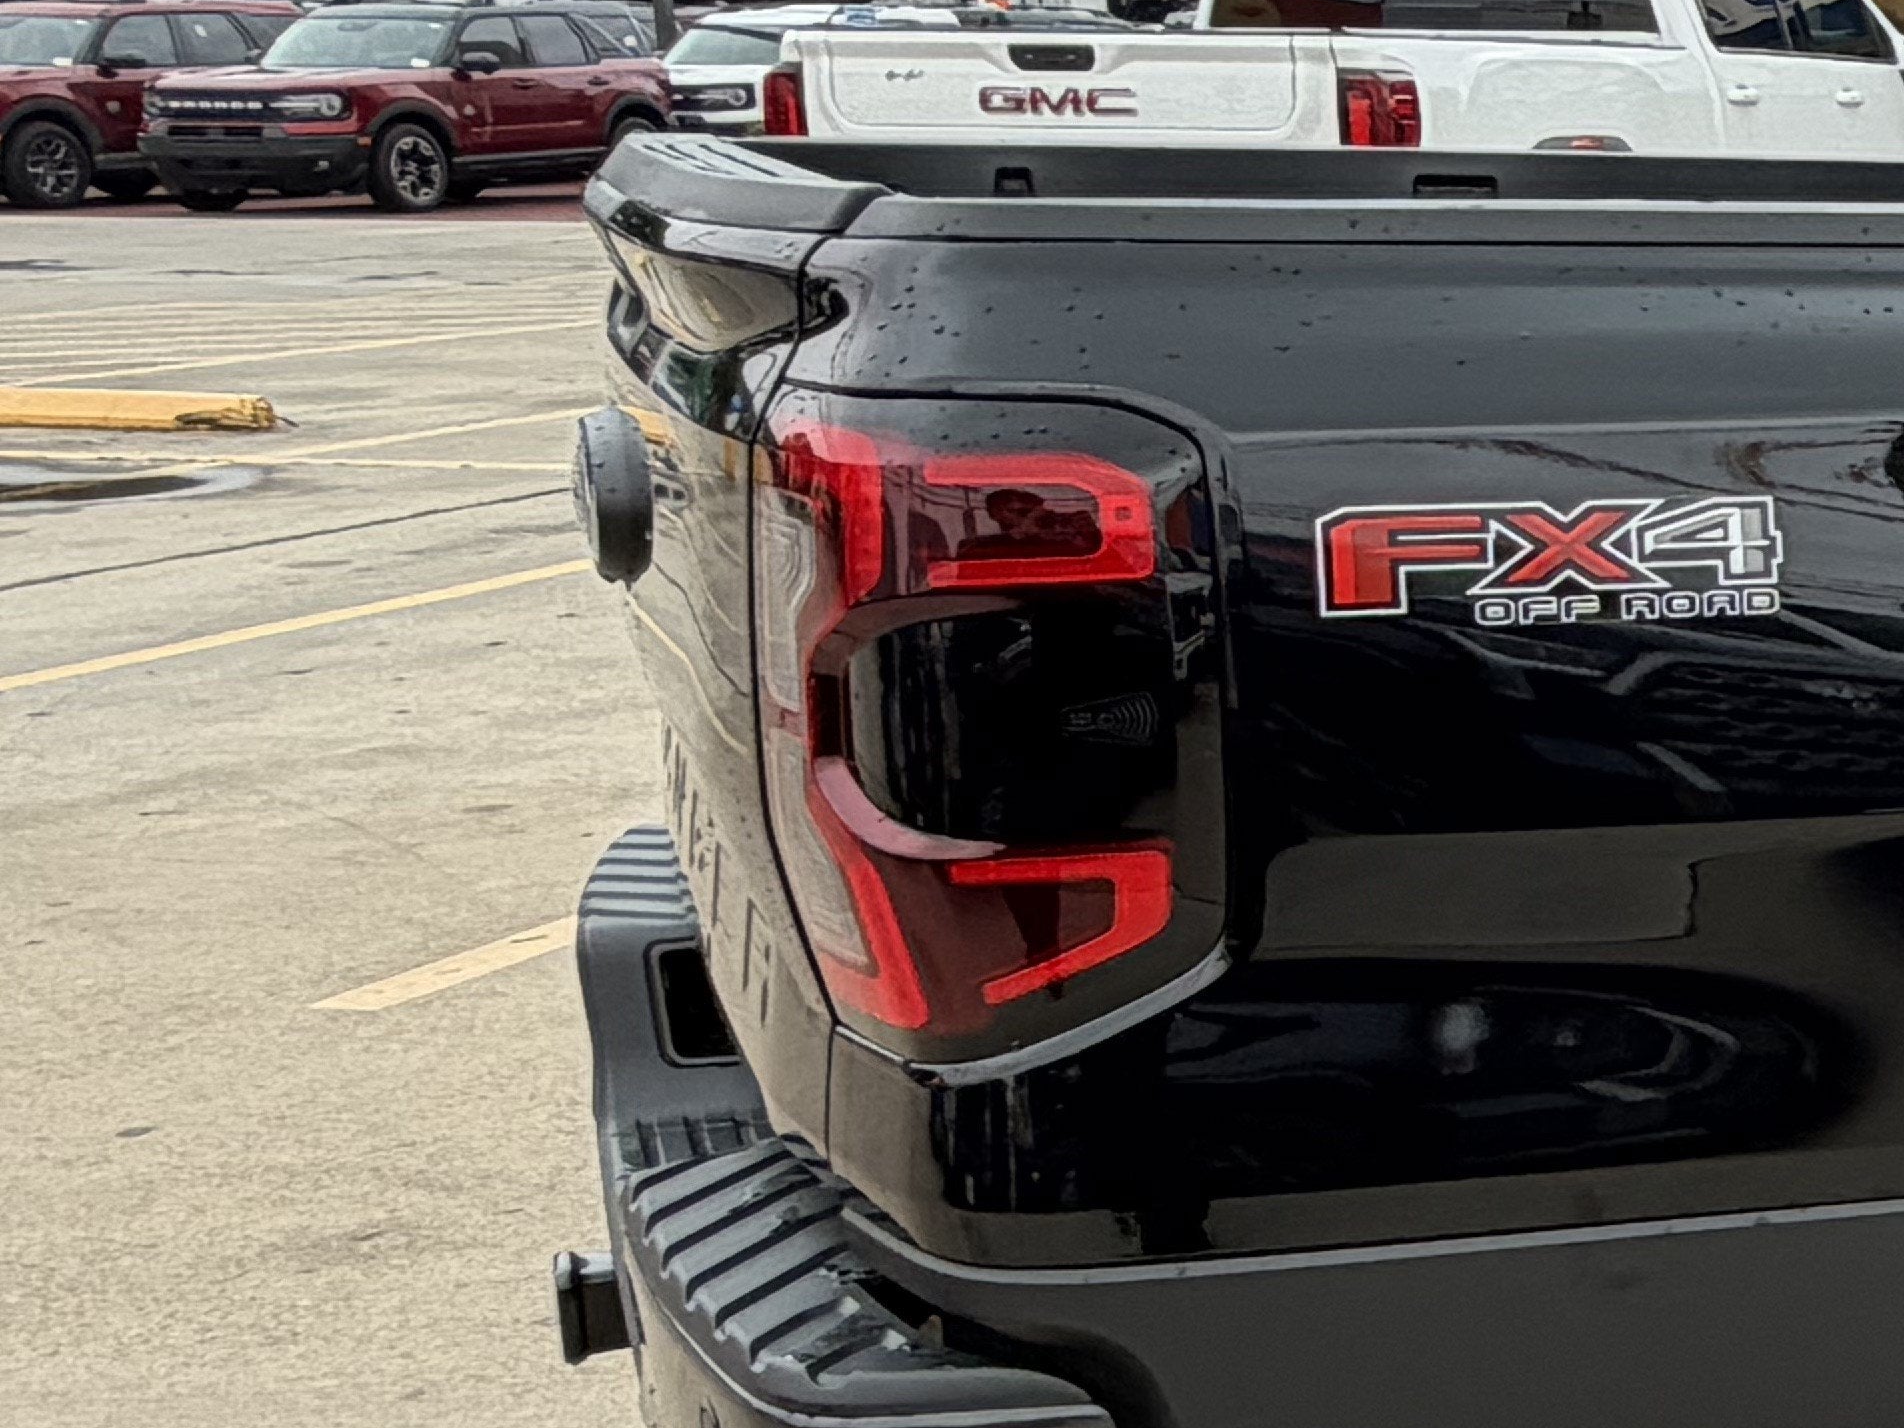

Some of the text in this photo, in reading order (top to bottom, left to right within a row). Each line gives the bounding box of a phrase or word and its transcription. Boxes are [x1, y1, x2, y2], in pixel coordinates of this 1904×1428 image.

[979, 86, 1139, 117] GMC
[1315, 496, 1783, 617] FX4
[1475, 588, 1781, 626] OFF ROAD
